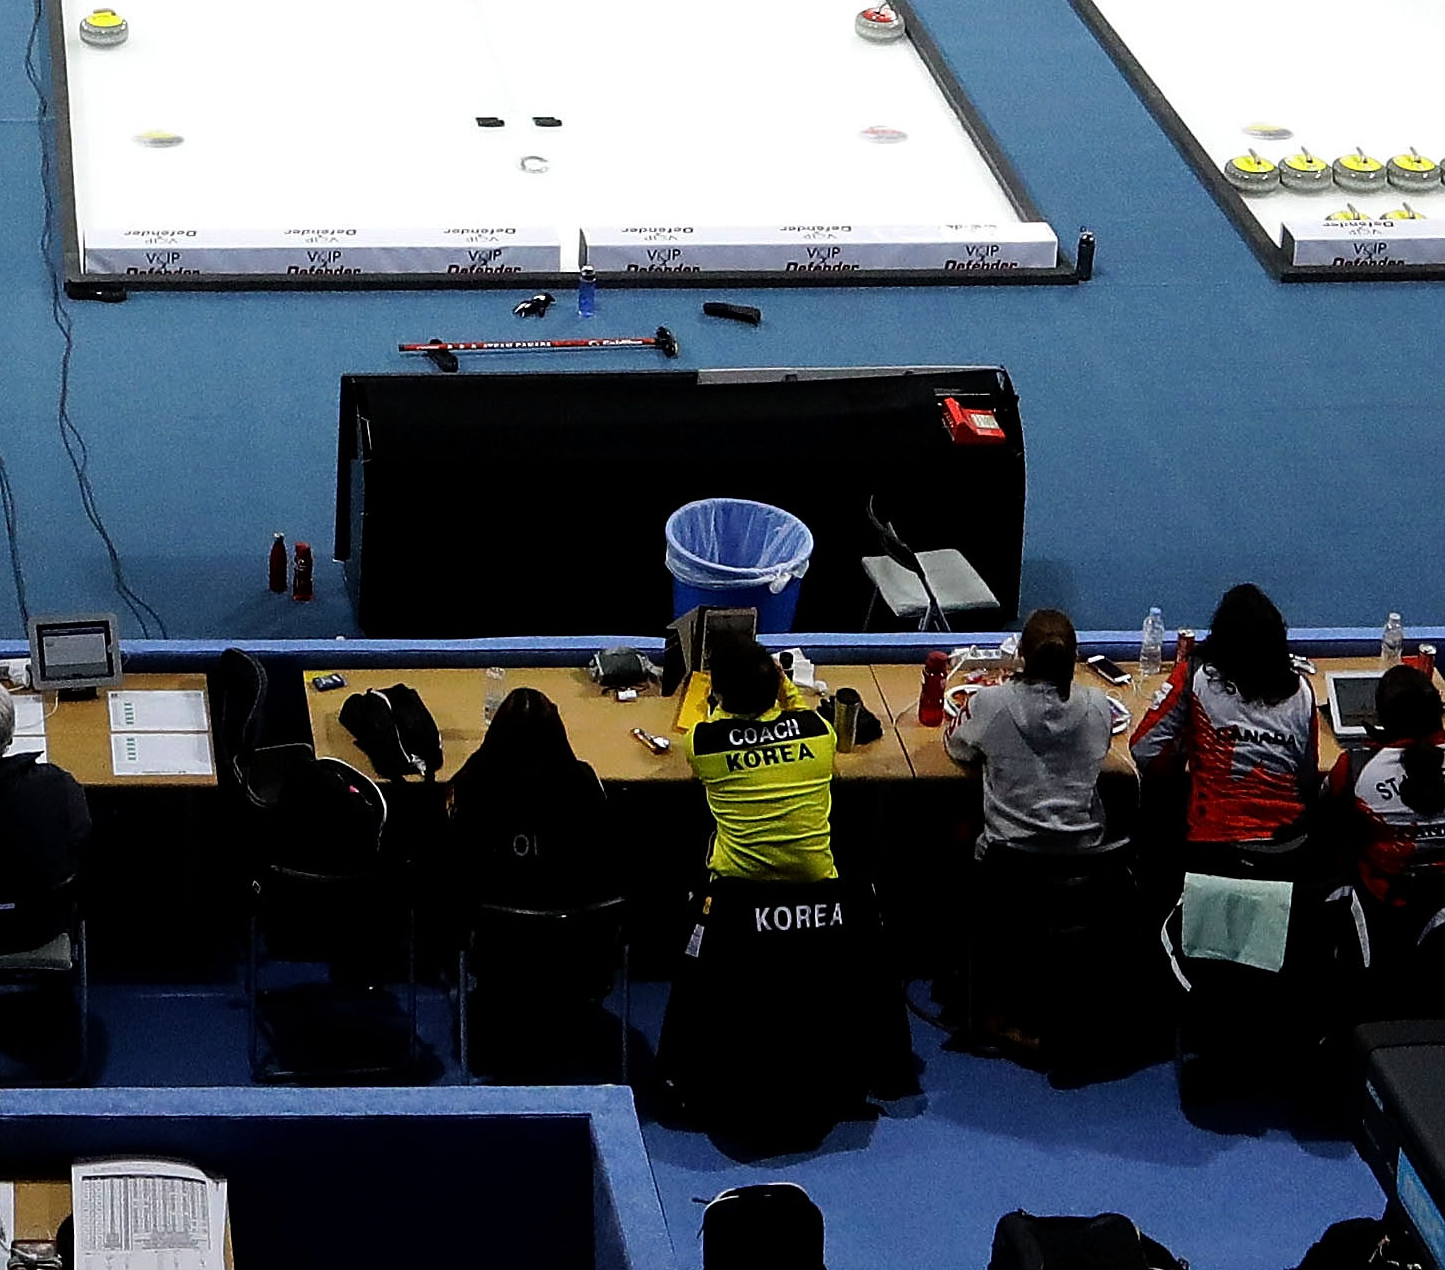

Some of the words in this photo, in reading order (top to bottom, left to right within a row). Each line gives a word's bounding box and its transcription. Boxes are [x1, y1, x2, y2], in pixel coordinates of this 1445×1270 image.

[520, 155, 550, 174] C
[728, 718, 801, 746] COACH
[725, 741, 815, 772] KOREA
[754, 902, 844, 933] KOREA
